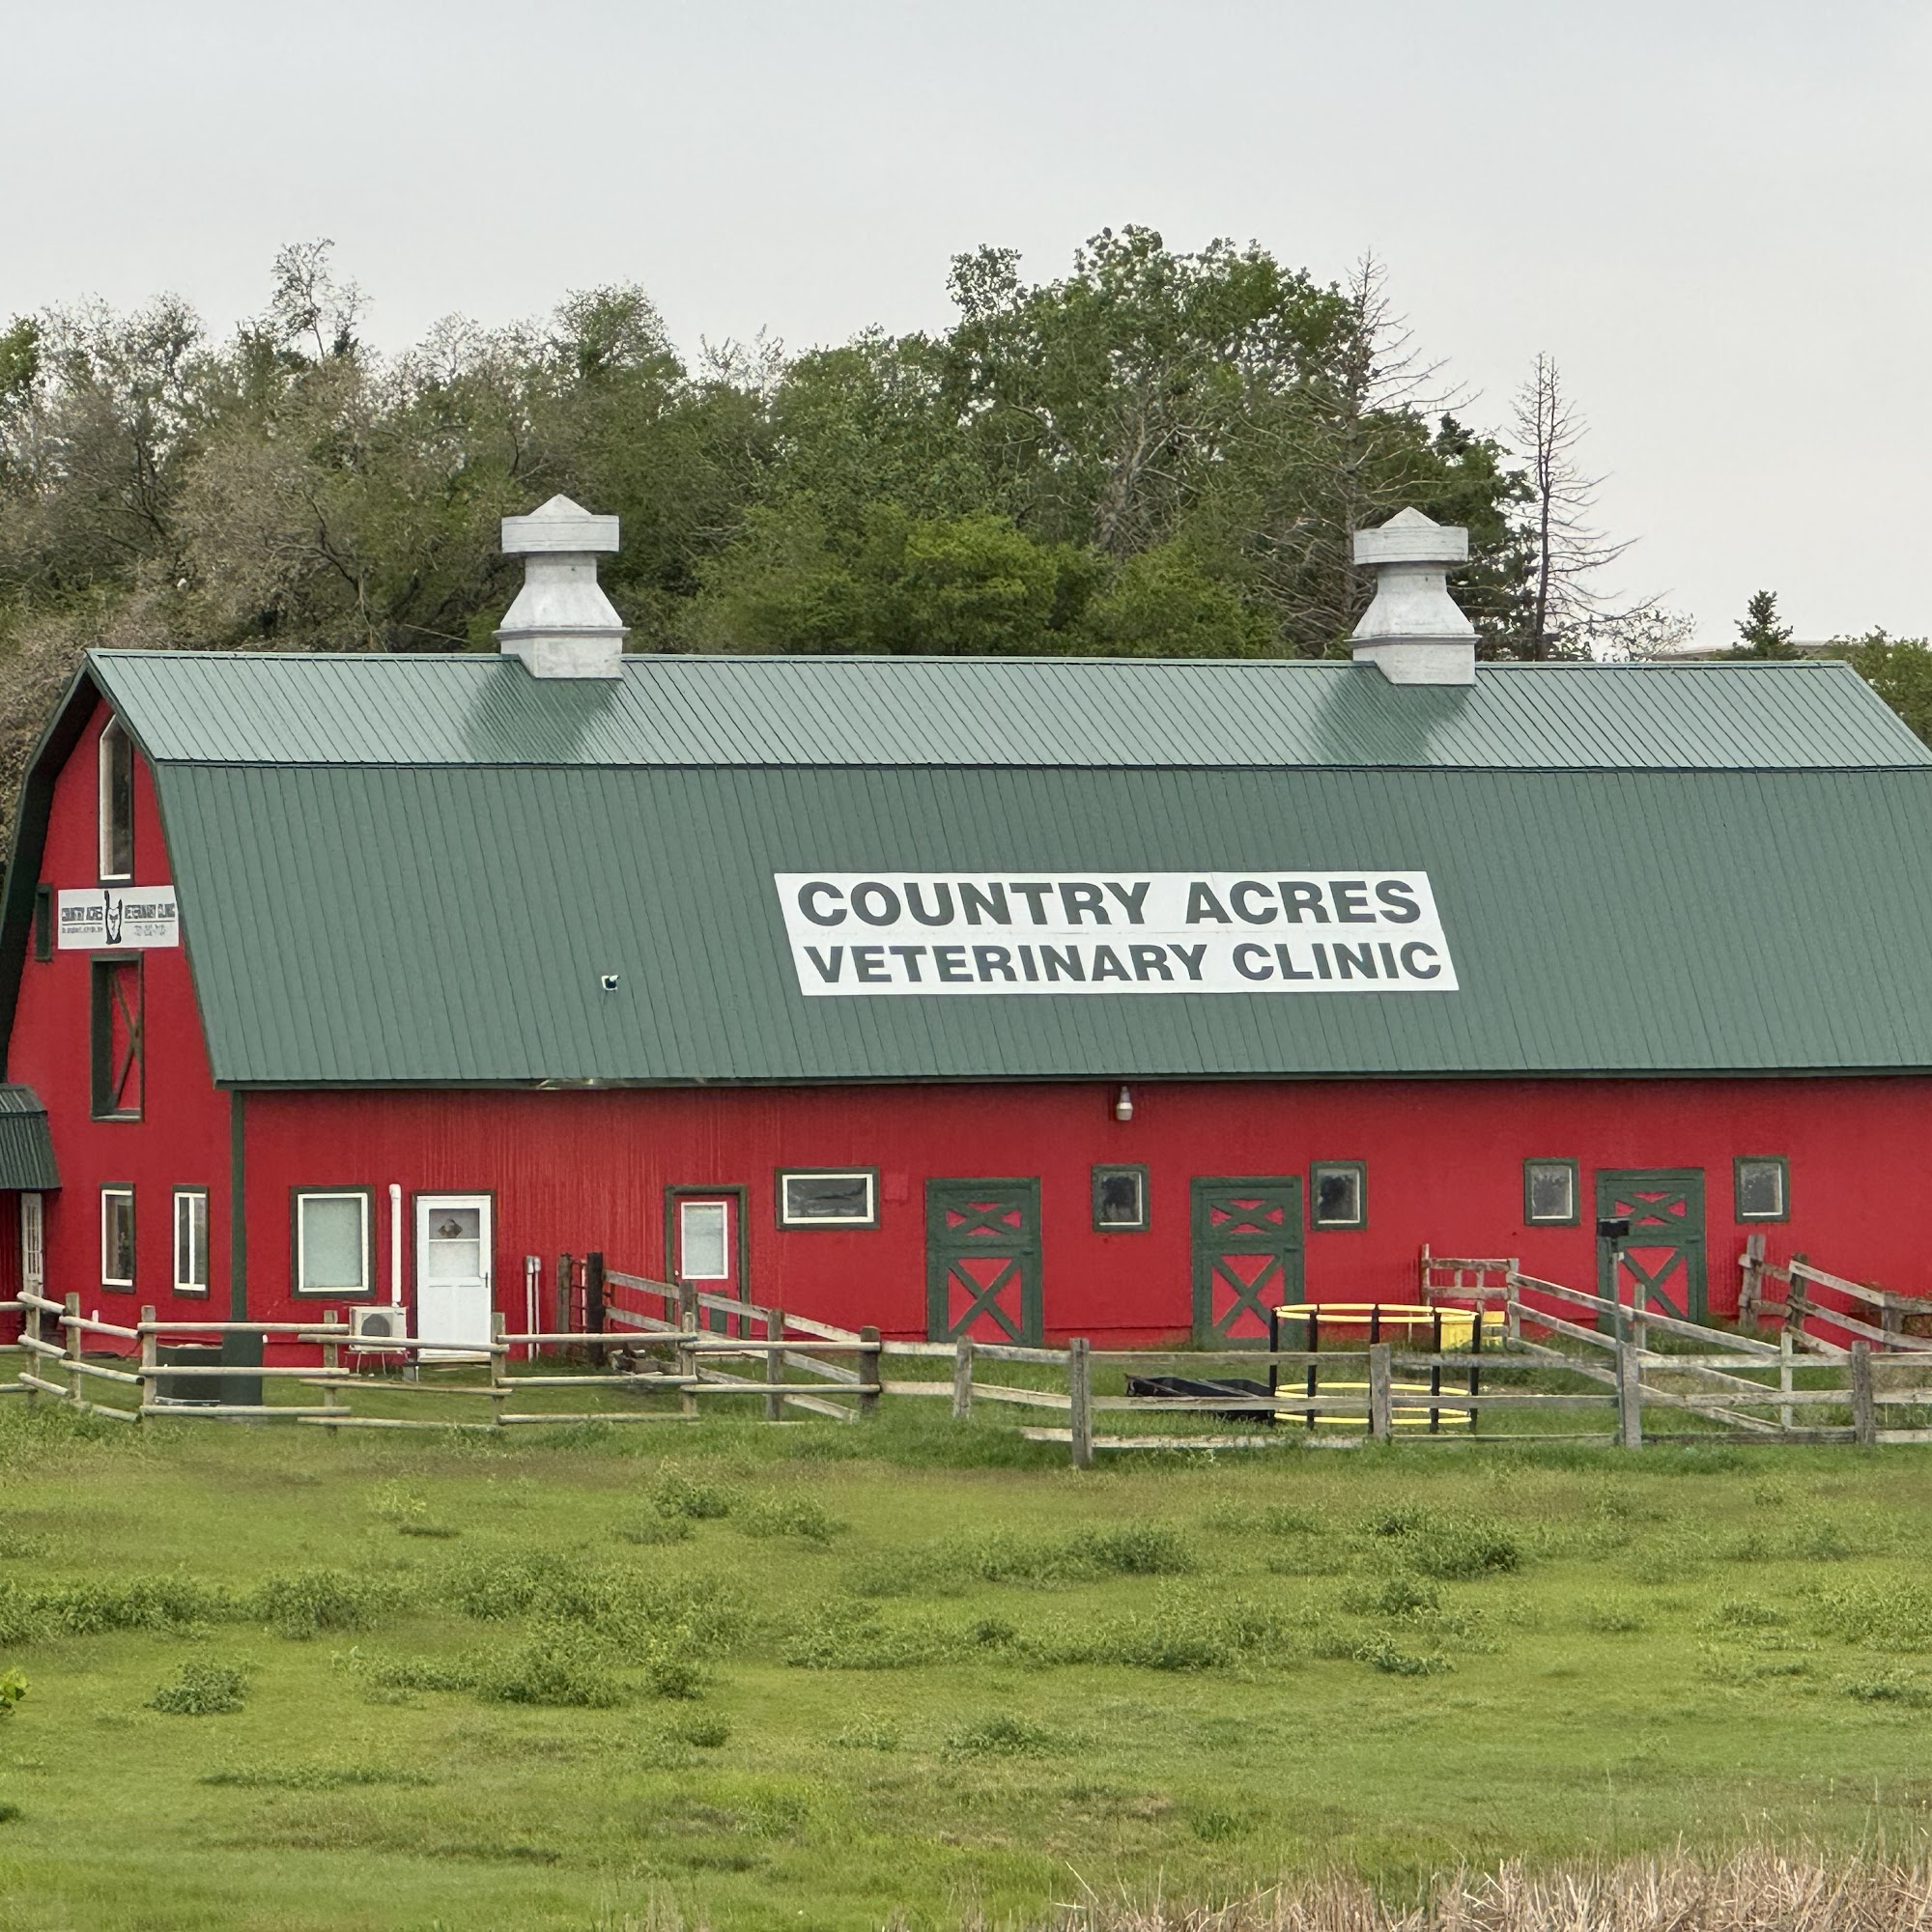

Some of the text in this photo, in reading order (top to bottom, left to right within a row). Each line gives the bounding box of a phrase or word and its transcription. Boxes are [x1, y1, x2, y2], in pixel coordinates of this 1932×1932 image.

[798, 880, 1420, 926] COUNTRY ACRES
[804, 942, 1441, 982] VETERINARY CLINIC
